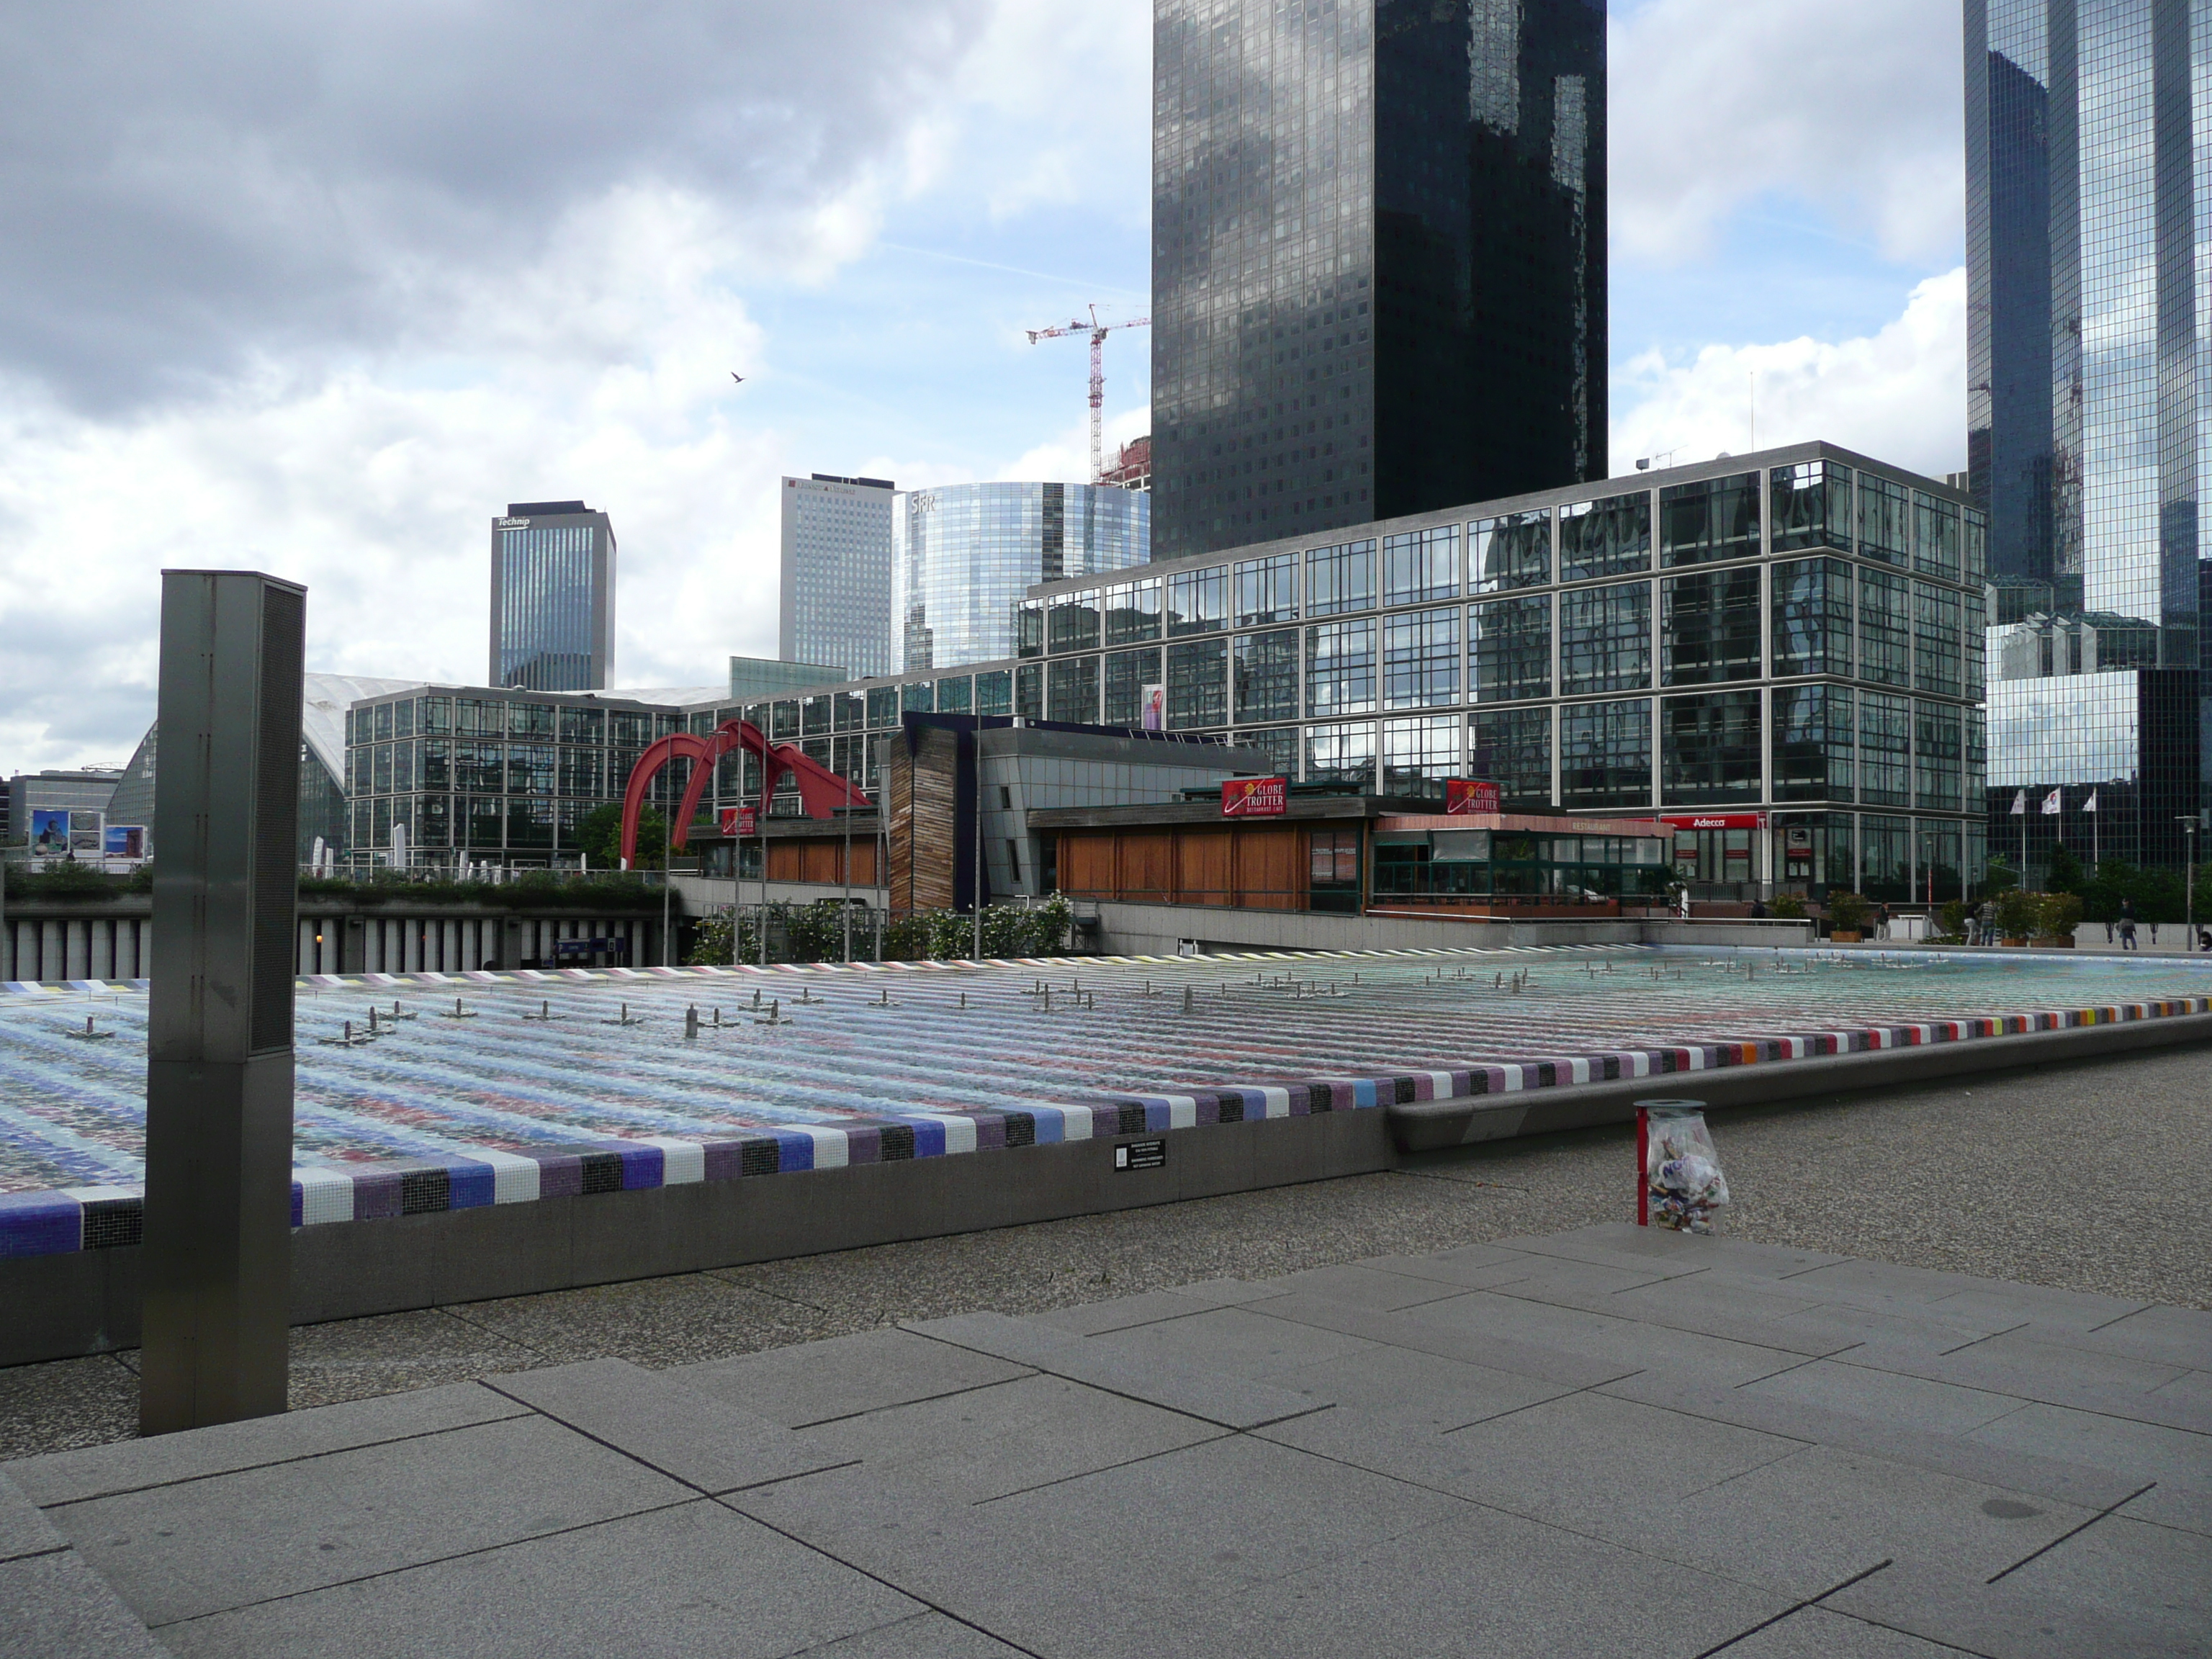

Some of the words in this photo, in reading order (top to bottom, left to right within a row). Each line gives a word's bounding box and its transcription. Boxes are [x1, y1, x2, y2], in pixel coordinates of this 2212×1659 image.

[912, 494, 935, 514] SFR
[498, 516, 530, 526] Technip
[1257, 785, 1284, 796] GLOBE
[1475, 788, 1497, 799] GLOBE
[1247, 795, 1284, 806] TROTTER
[1467, 799, 1498, 810] TROTTER
[1572, 822, 1611, 832] RESTAURANT
[1693, 817, 1725, 827] Adecco
